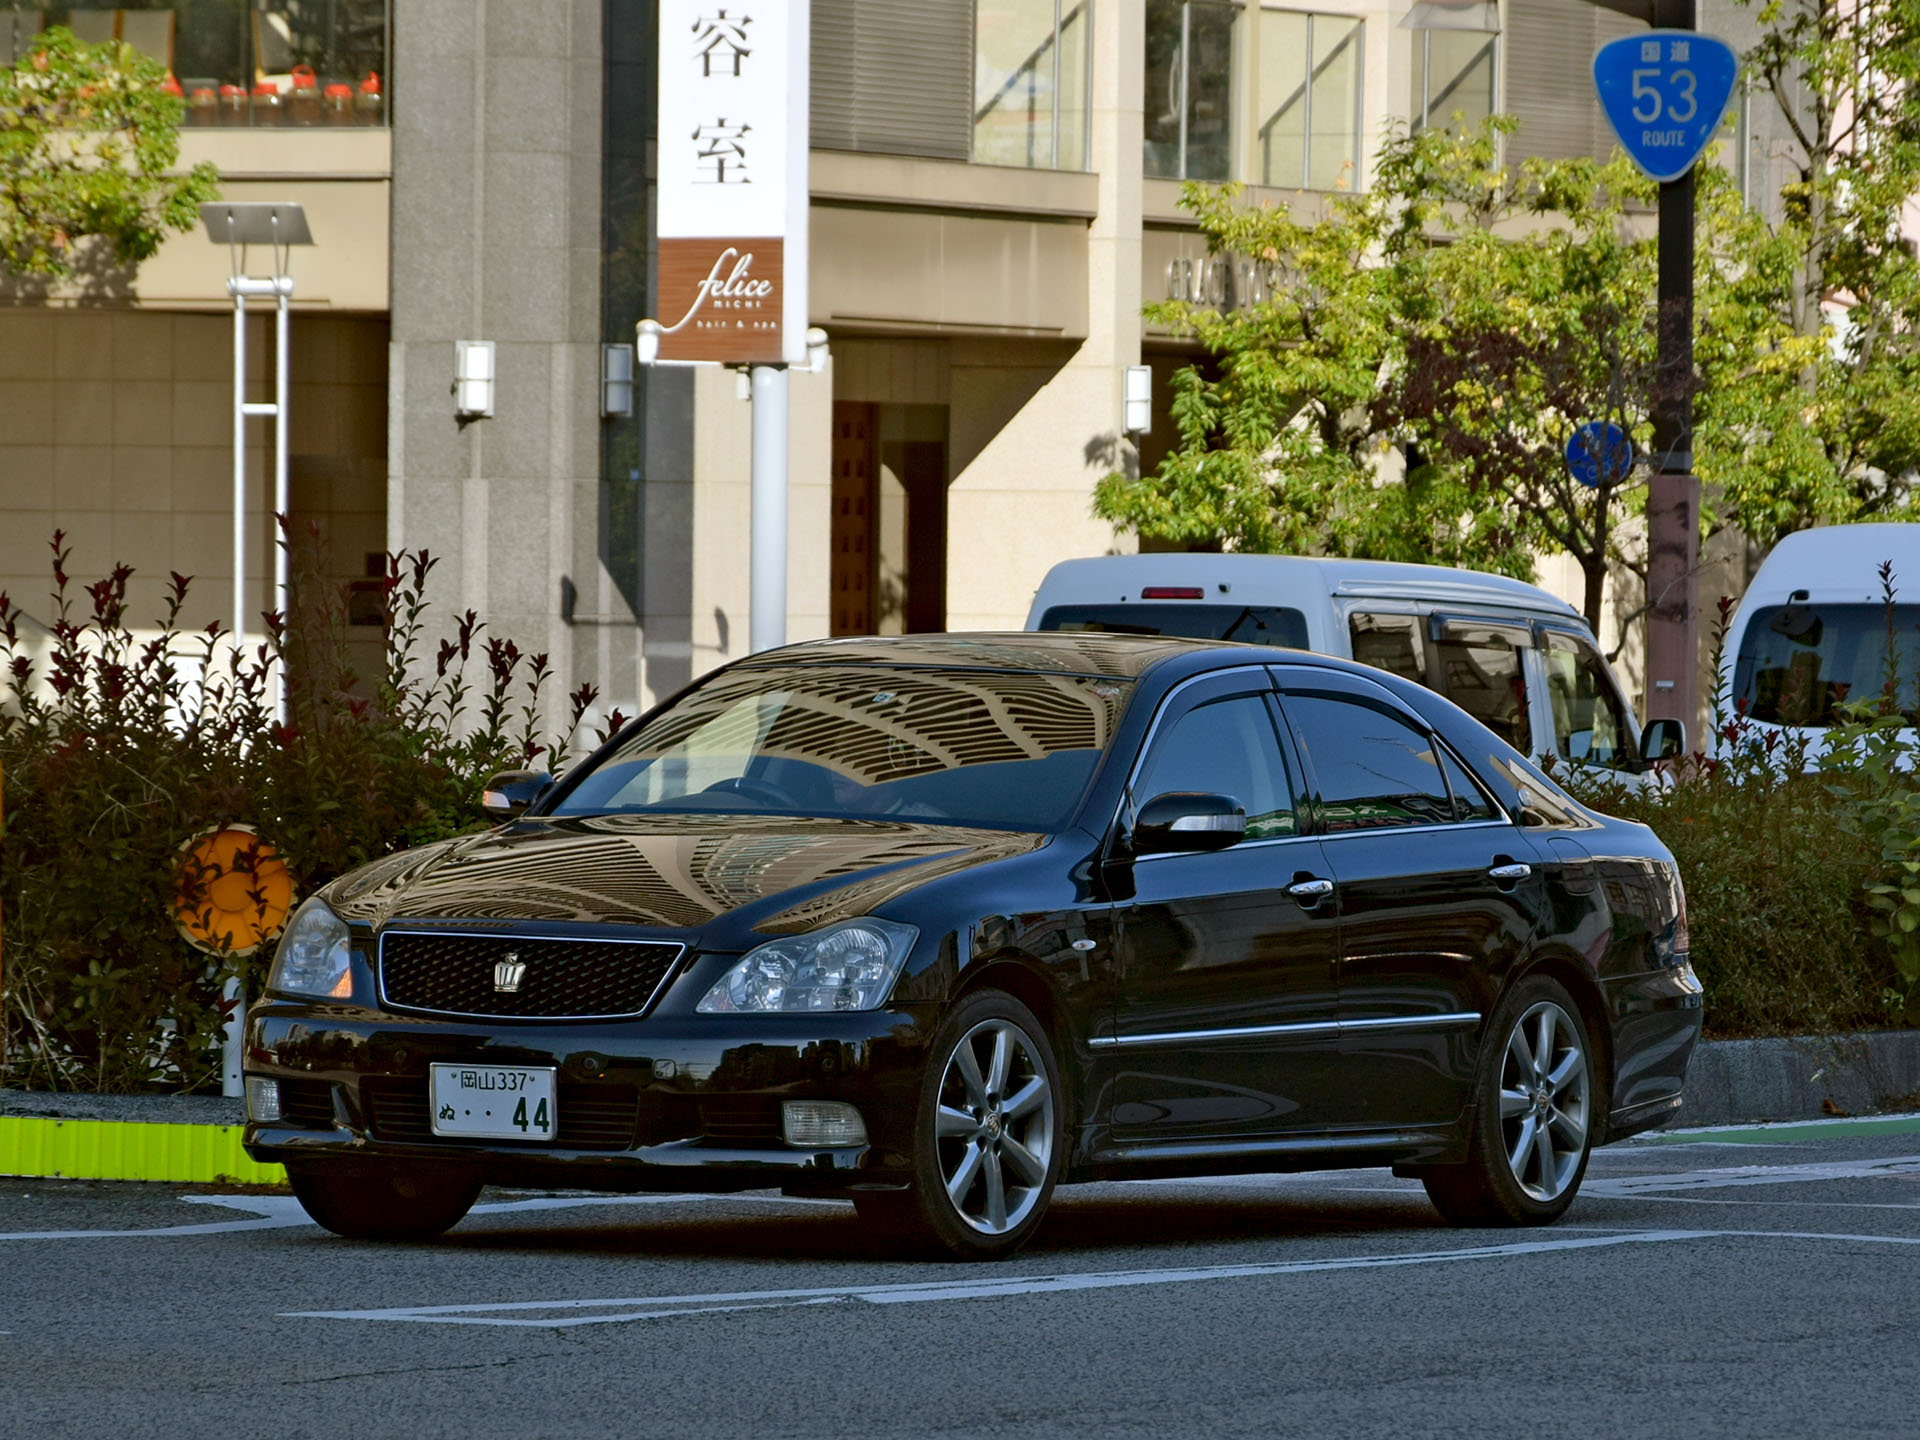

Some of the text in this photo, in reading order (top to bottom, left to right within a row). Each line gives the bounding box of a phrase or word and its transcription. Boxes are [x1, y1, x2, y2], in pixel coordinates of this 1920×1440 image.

[1641, 41, 1690, 62] 国道
[1632, 68, 1698, 123] 53
[1642, 130, 1685, 147] ROUTE
[664, 247, 773, 332] felice
